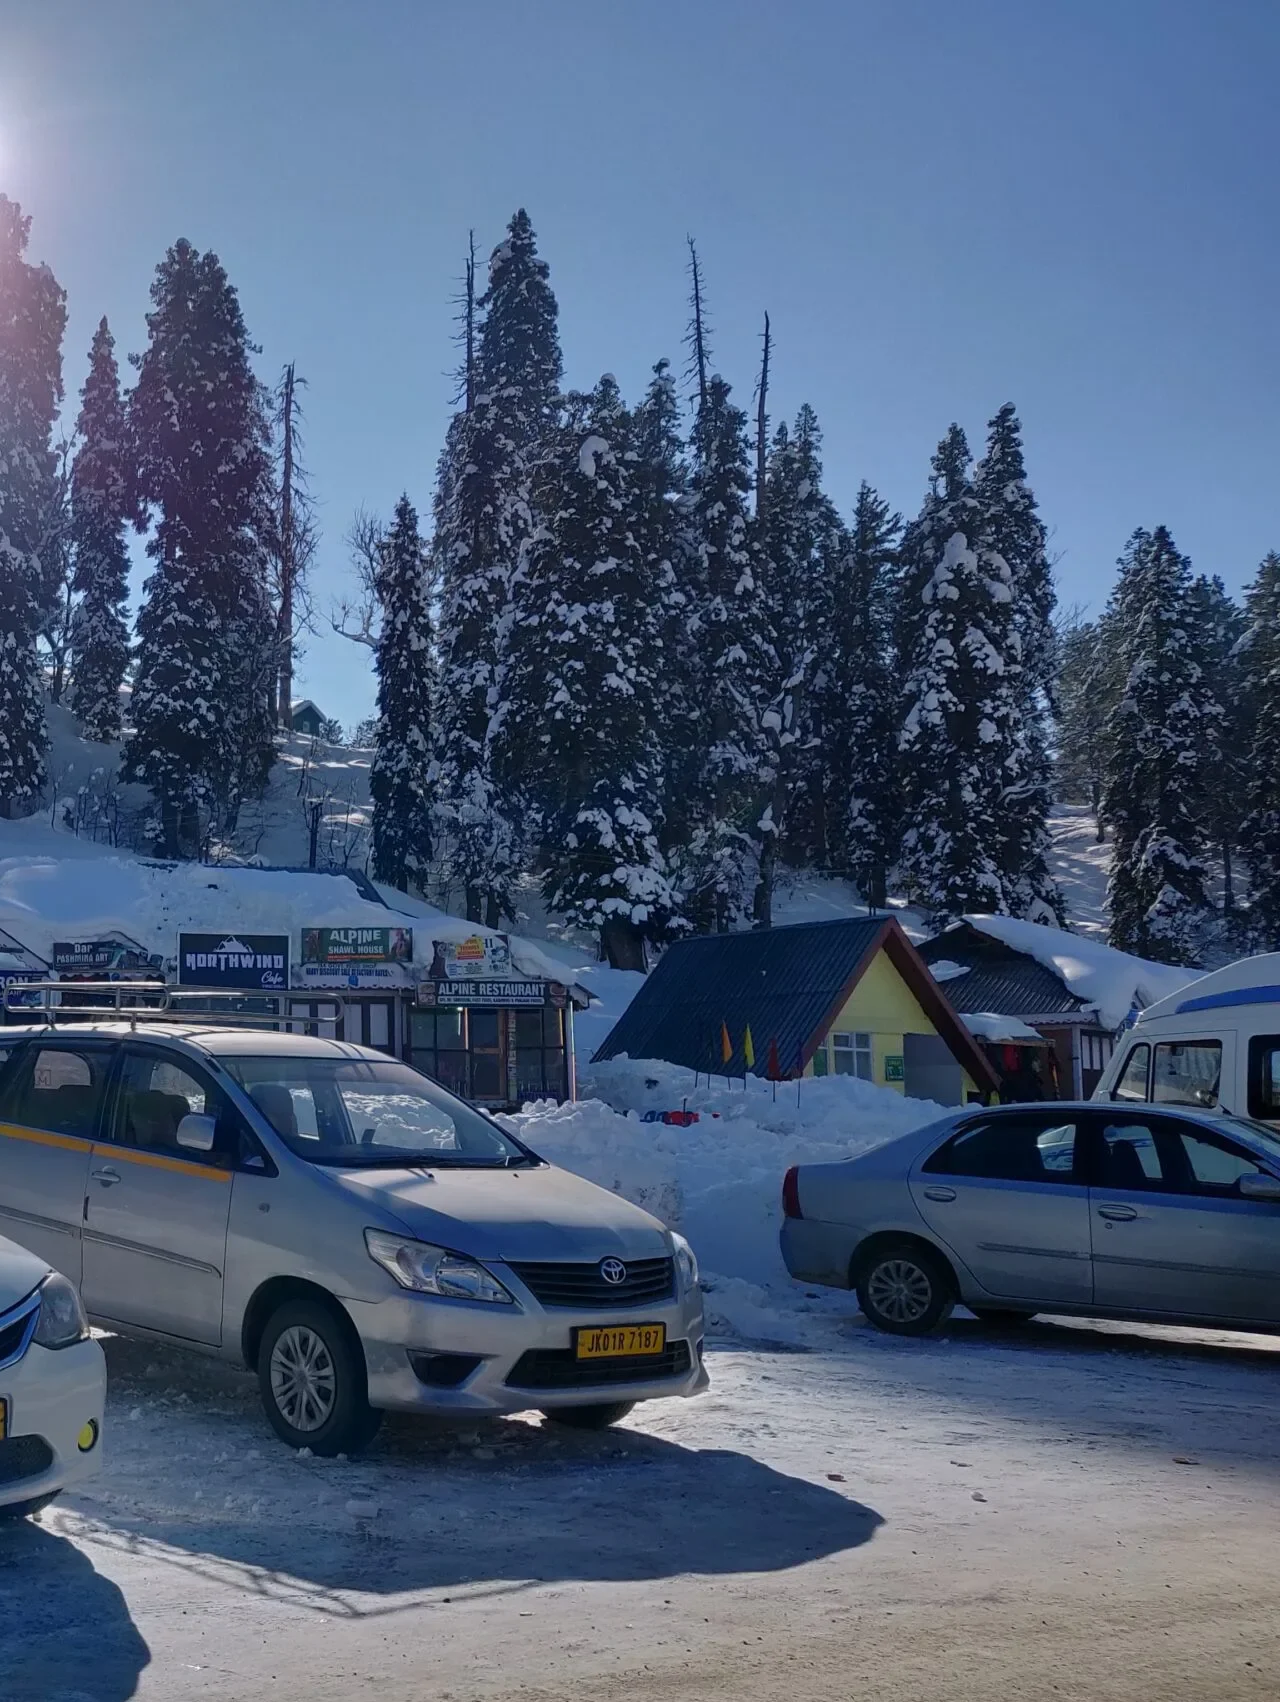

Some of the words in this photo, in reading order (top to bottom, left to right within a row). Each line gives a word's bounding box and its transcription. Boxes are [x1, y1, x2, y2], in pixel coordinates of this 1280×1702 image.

[330, 930, 382, 944] ALPINE
[74, 944, 93, 953] Dar
[328, 946, 356, 954] SHAWL
[358, 946, 384, 954] HOUSE
[56, 953, 94, 963] PASHMINA
[186, 953, 284, 971] NORTHWIND
[261, 971, 284, 984] Cafe
[438, 983, 476, 995] ALPINE
[480, 983, 545, 996] RESTAURANT
[587, 1332, 624, 1352] JK01R
[629, 1331, 659, 1348] 7187
